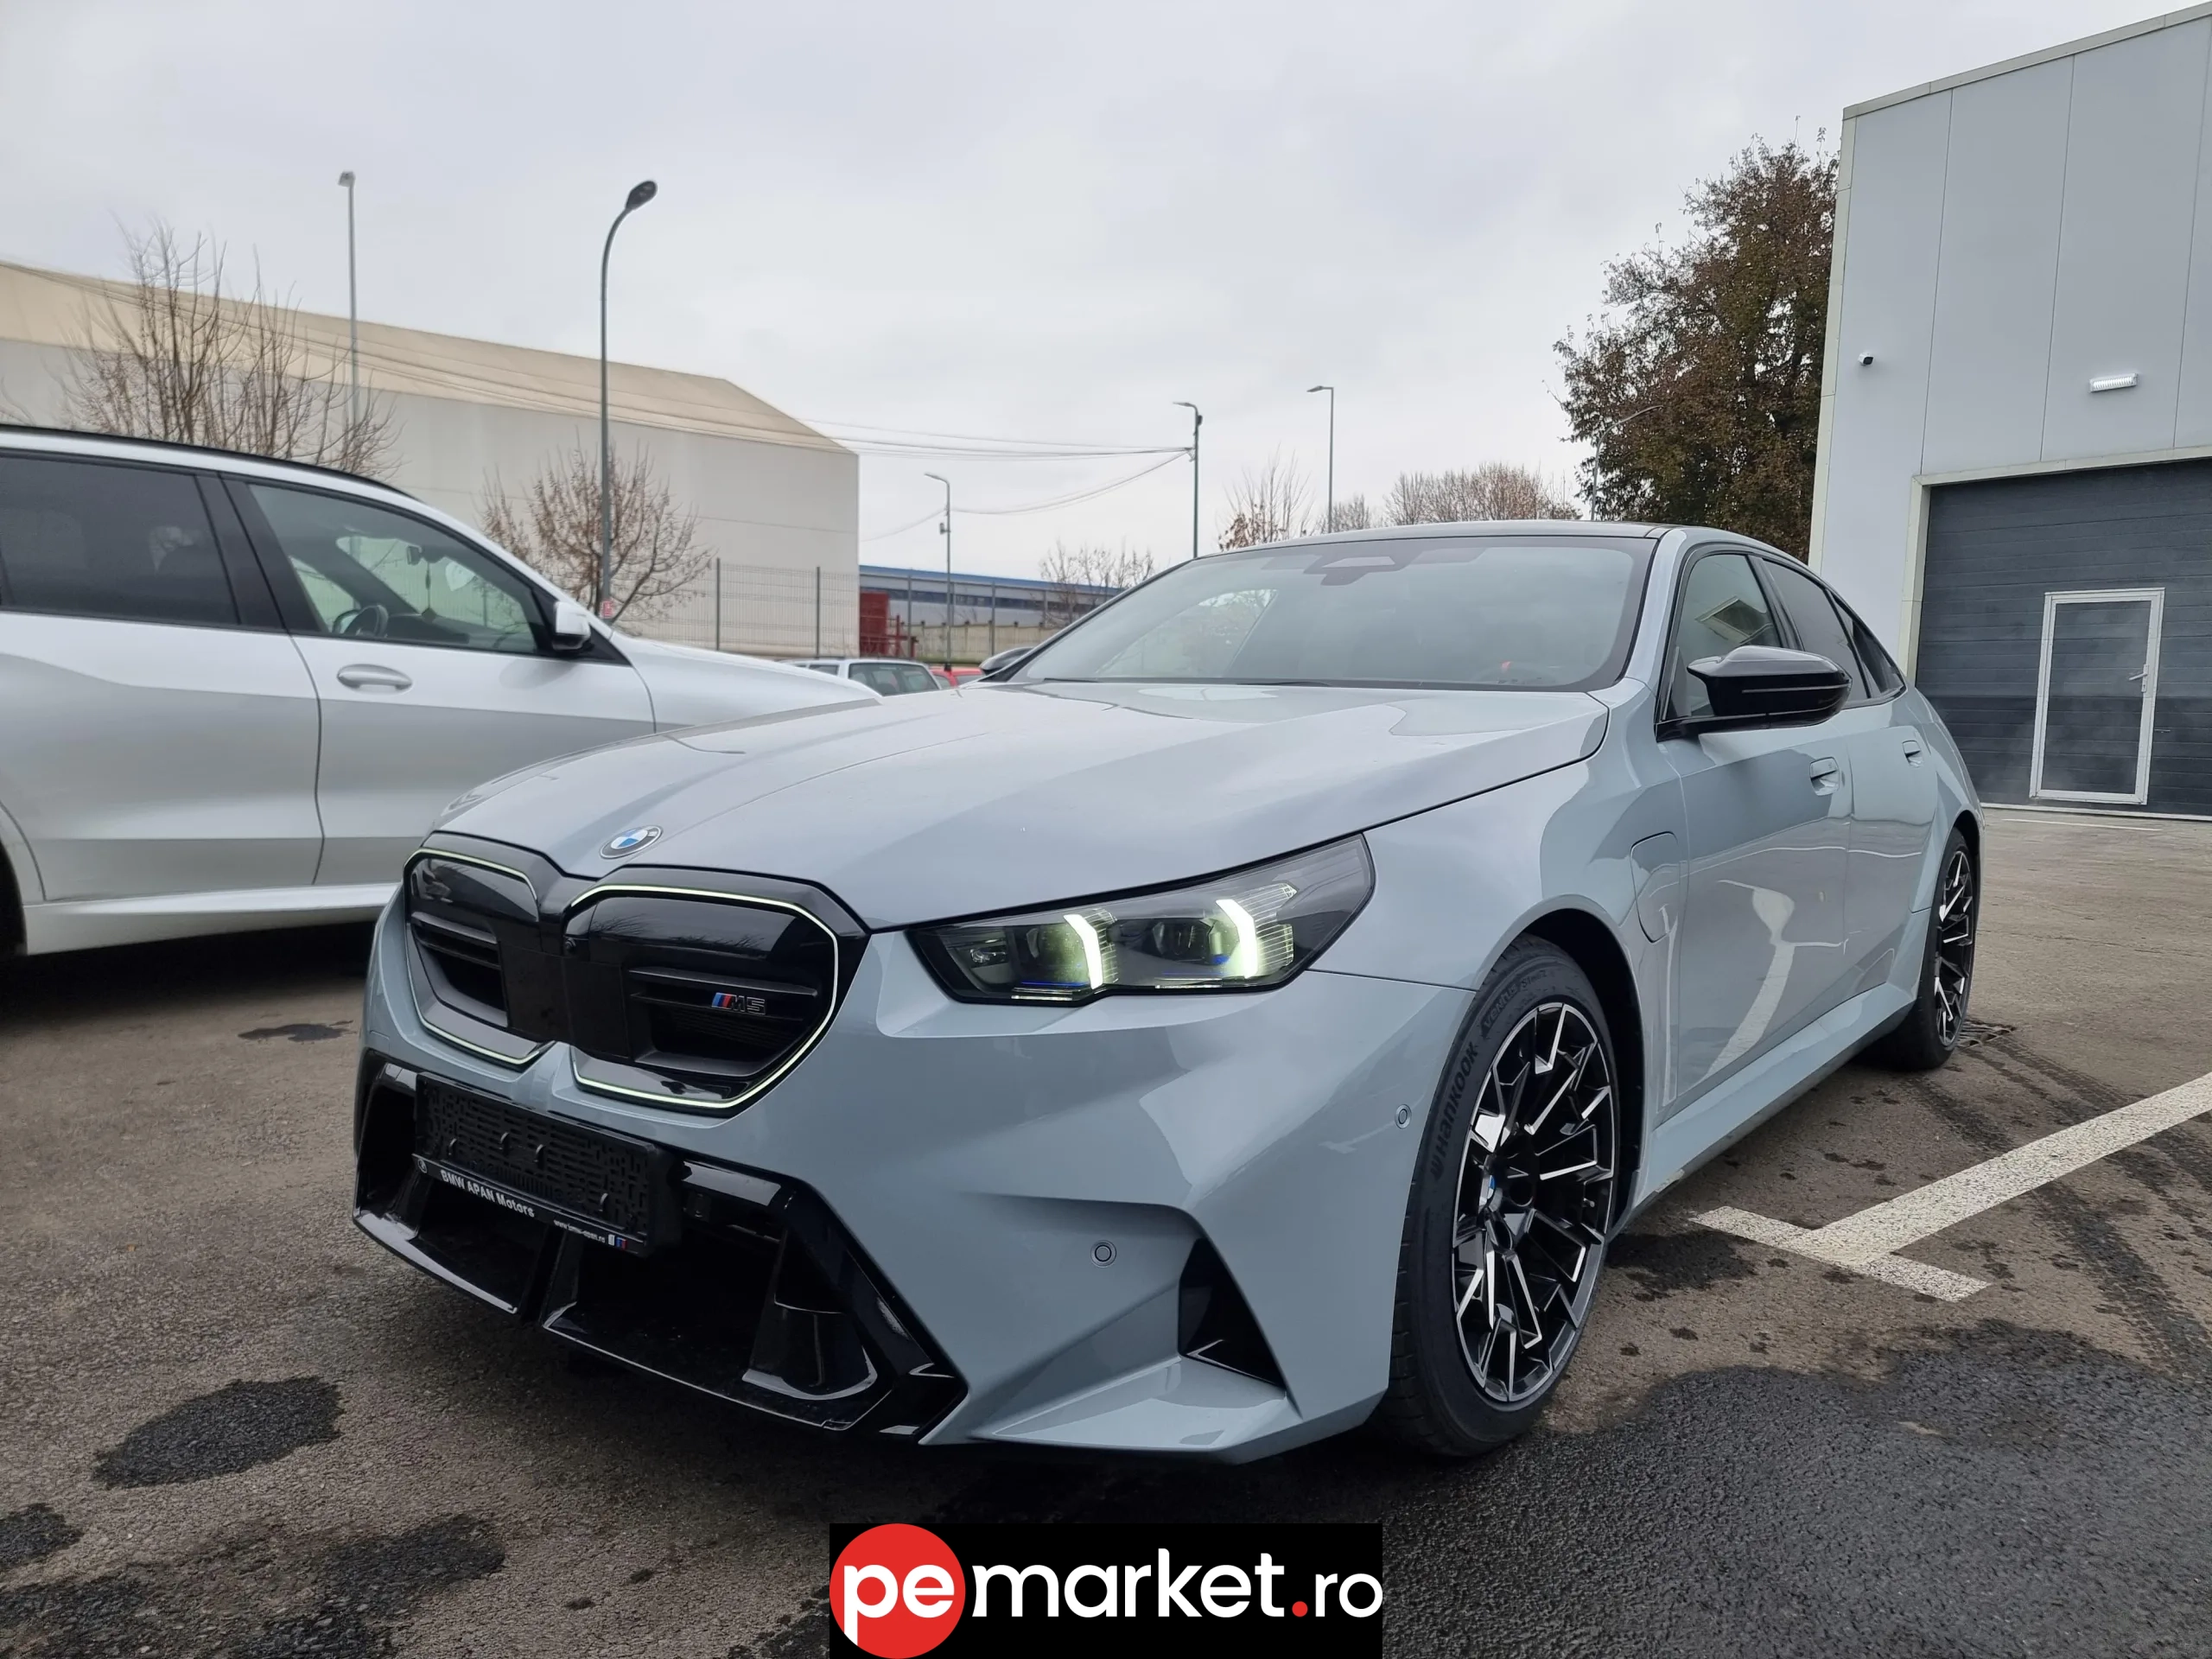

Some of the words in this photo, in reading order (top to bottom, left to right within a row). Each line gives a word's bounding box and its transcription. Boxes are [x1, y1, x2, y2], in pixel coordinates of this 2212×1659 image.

[725, 993, 766, 1016] M5
[440, 1169, 466, 1190] BMW
[467, 1180, 496, 1203] APAN
[495, 1192, 535, 1217] Motors
